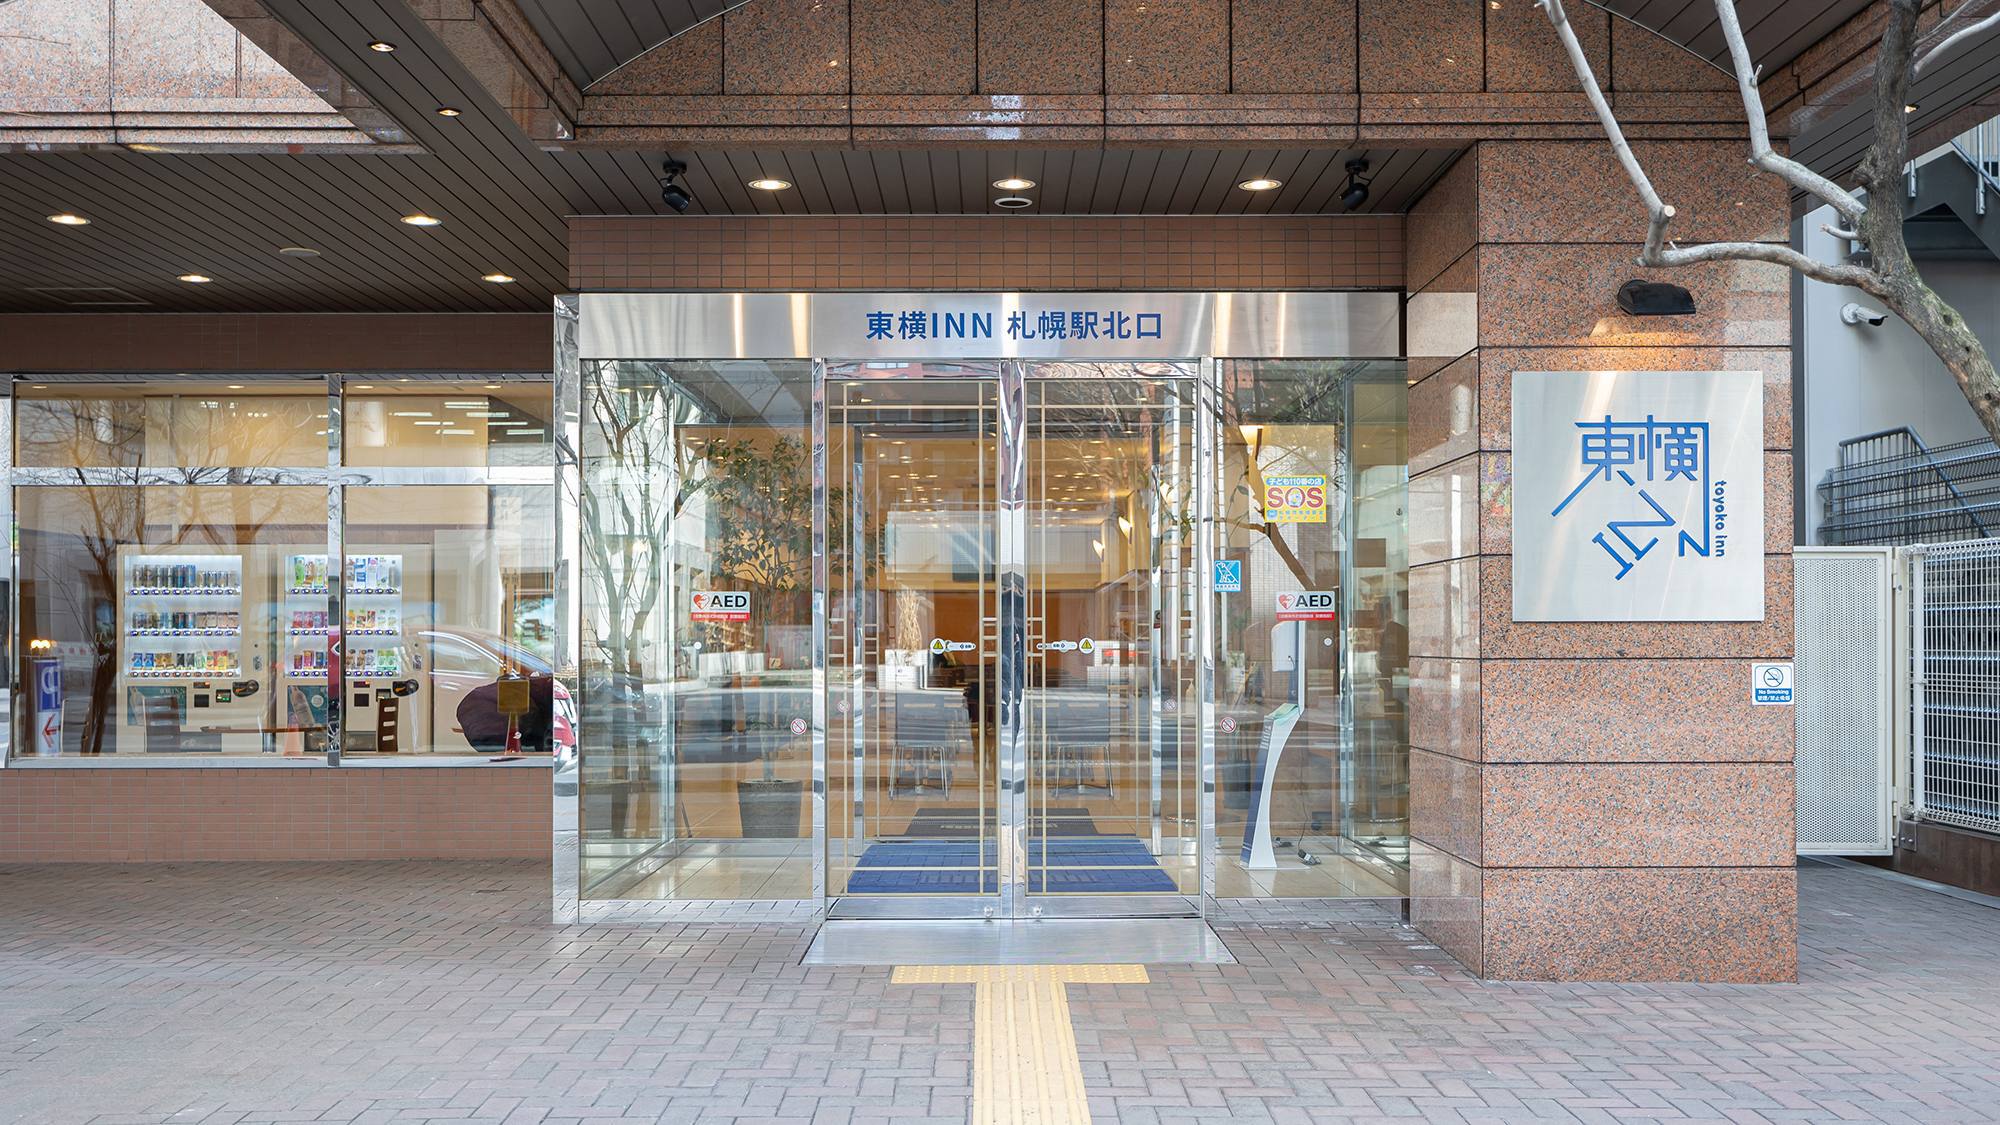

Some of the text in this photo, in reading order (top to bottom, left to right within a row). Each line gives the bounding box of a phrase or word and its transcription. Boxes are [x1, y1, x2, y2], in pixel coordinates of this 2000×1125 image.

[866, 311, 1162, 340] 東横INN 札幌駅北口
[1267, 487, 1324, 508] SOS
[1712, 480, 1728, 557] toyoko inn
[710, 595, 747, 608] AED
[1296, 594, 1332, 607] AED
